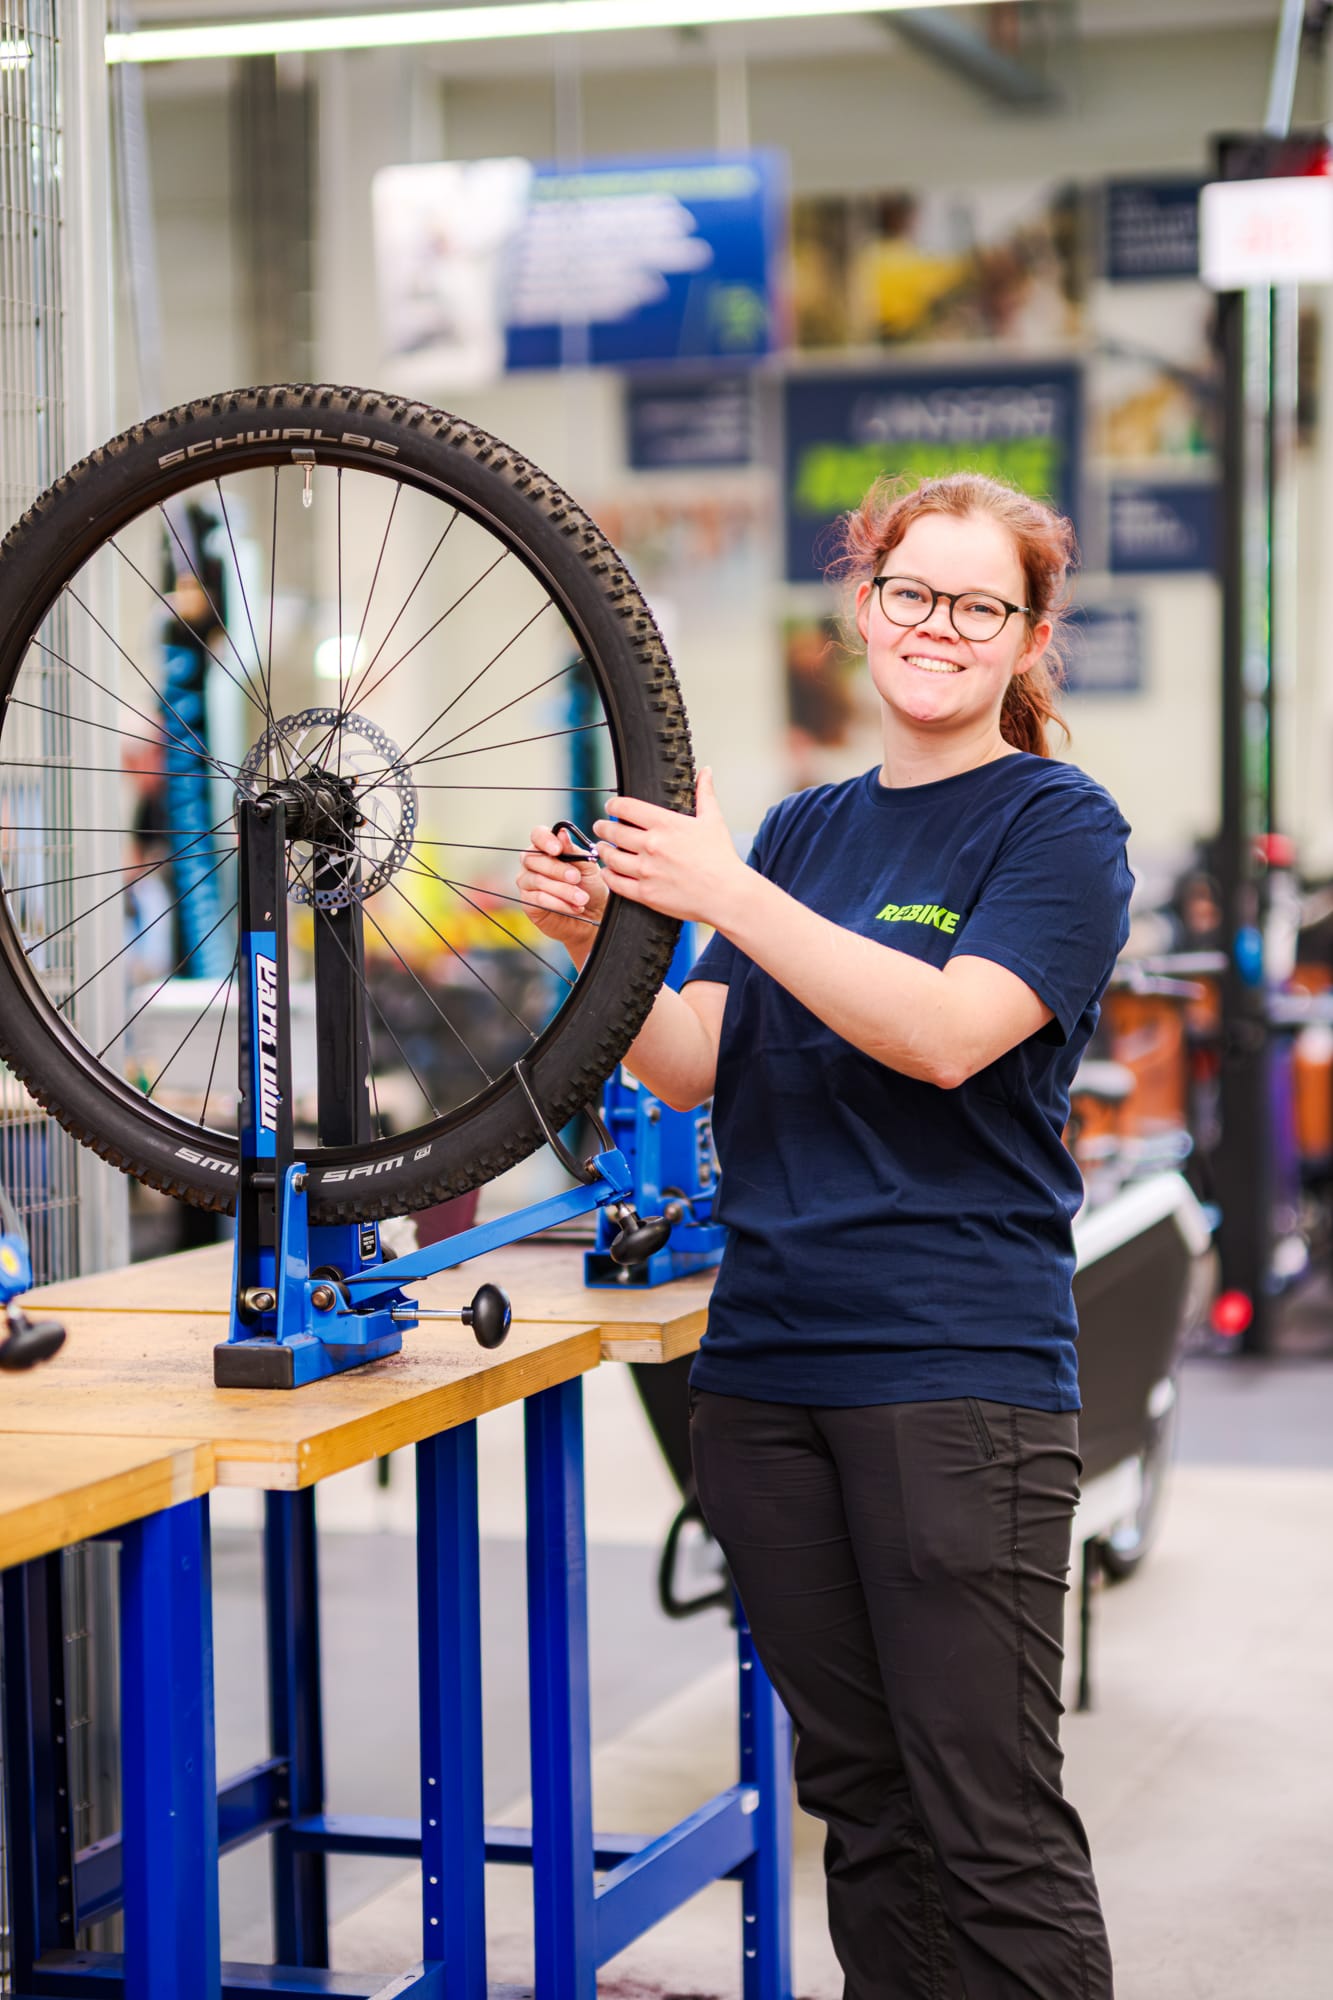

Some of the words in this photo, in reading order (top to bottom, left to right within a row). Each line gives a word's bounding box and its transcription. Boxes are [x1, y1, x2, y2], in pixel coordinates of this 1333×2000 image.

[158, 428, 400, 470] SCHWALBE
[875, 904, 960, 934] REBIKE
[321, 1155, 404, 1183] SAM
